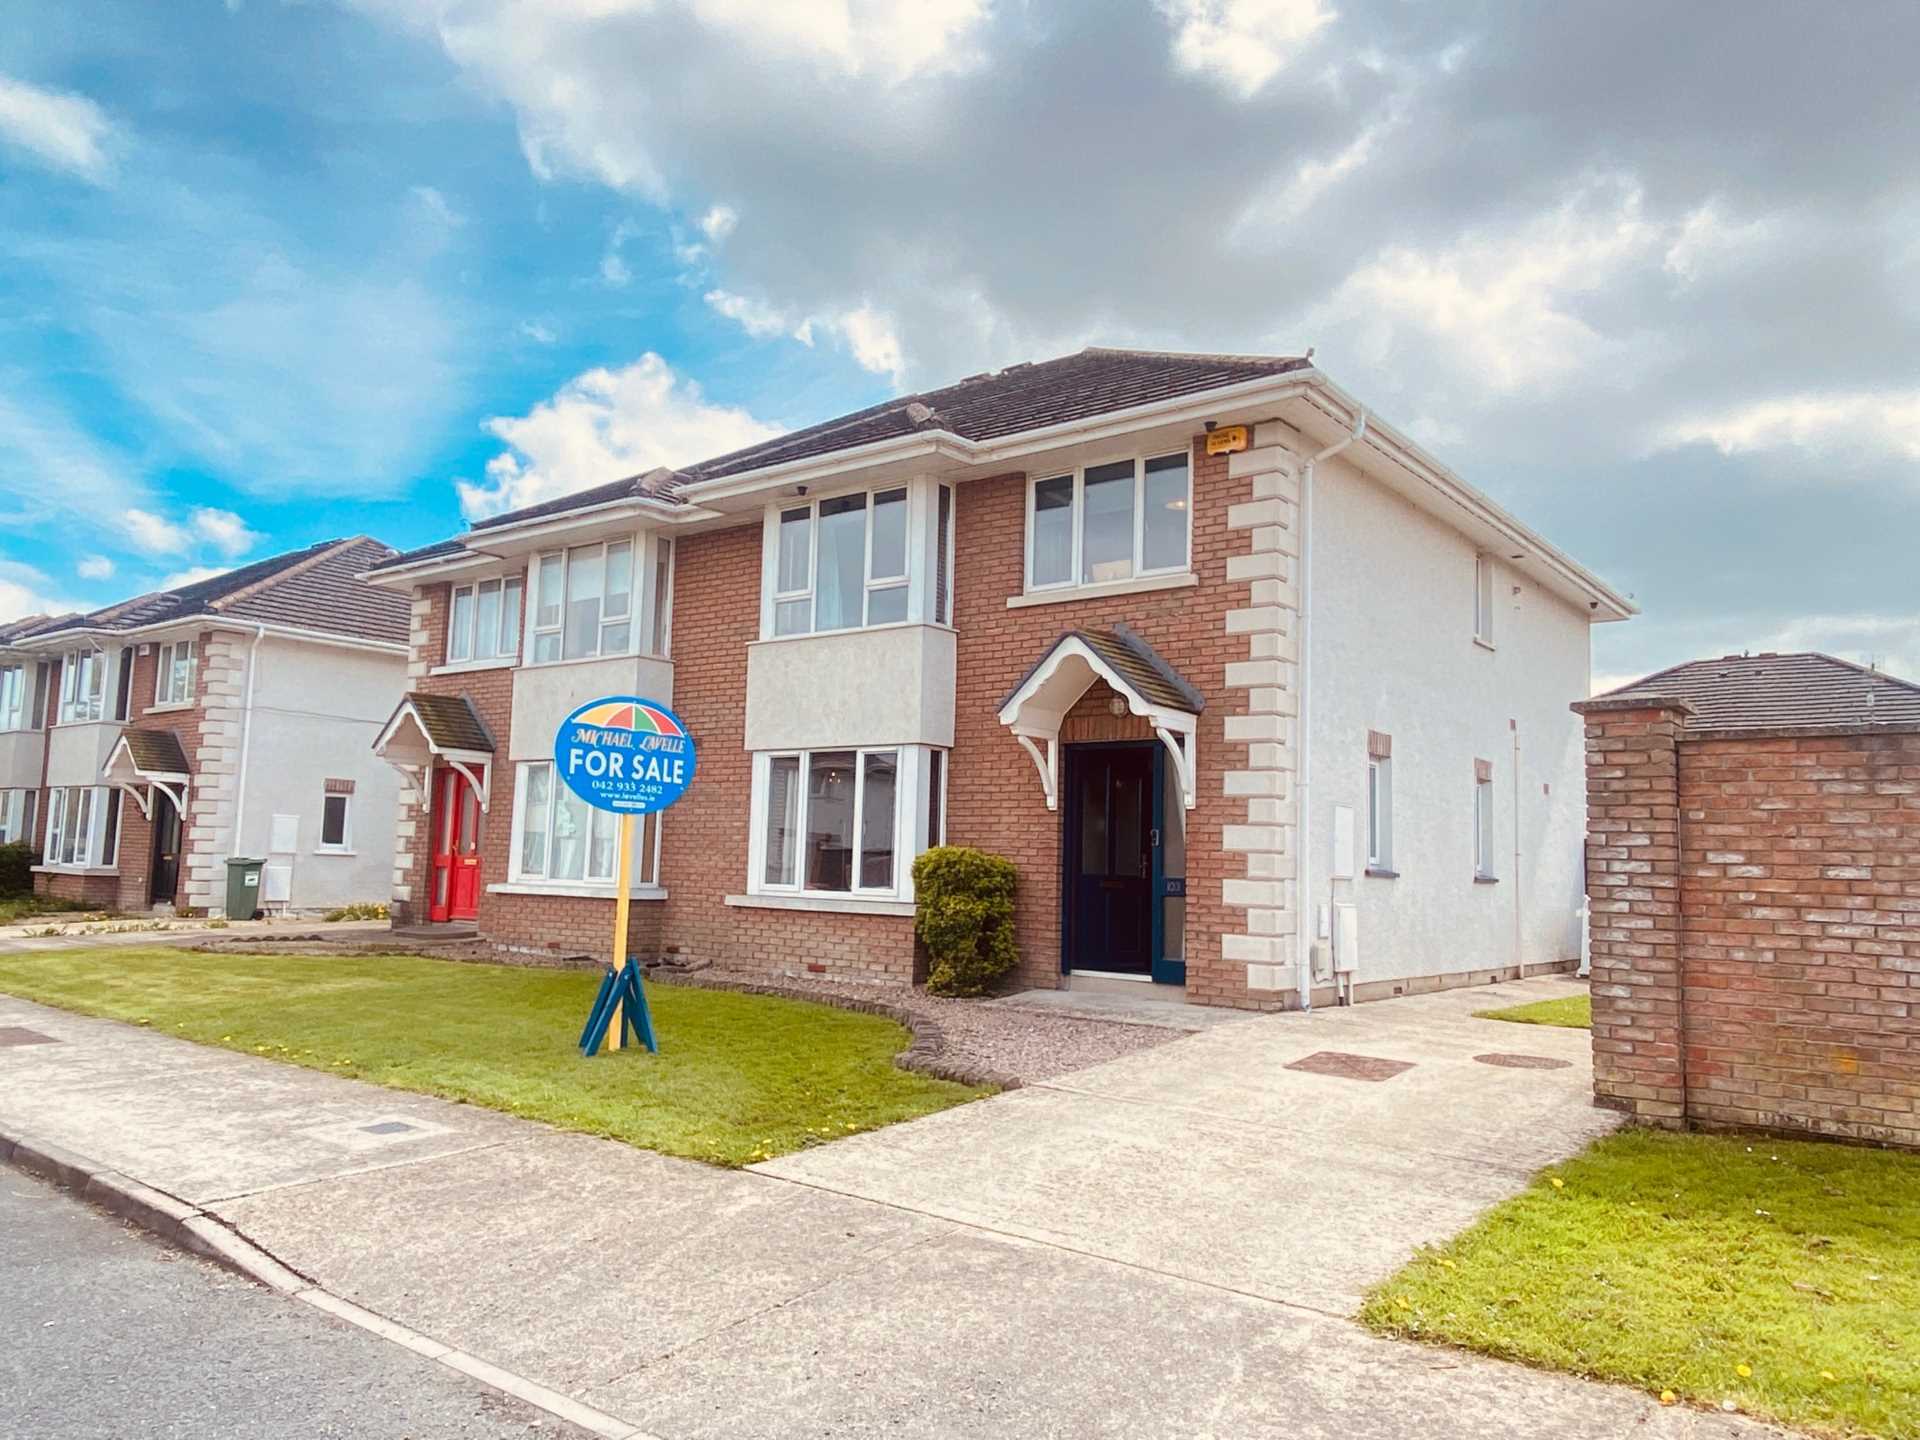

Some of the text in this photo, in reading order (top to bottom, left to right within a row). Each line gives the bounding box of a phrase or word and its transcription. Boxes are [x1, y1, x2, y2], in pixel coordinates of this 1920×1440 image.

[571, 728, 685, 754] MICHAEL LAVELLE
[569, 748, 684, 785] FOR SALE
[591, 780, 663, 795] 042 933 2482
